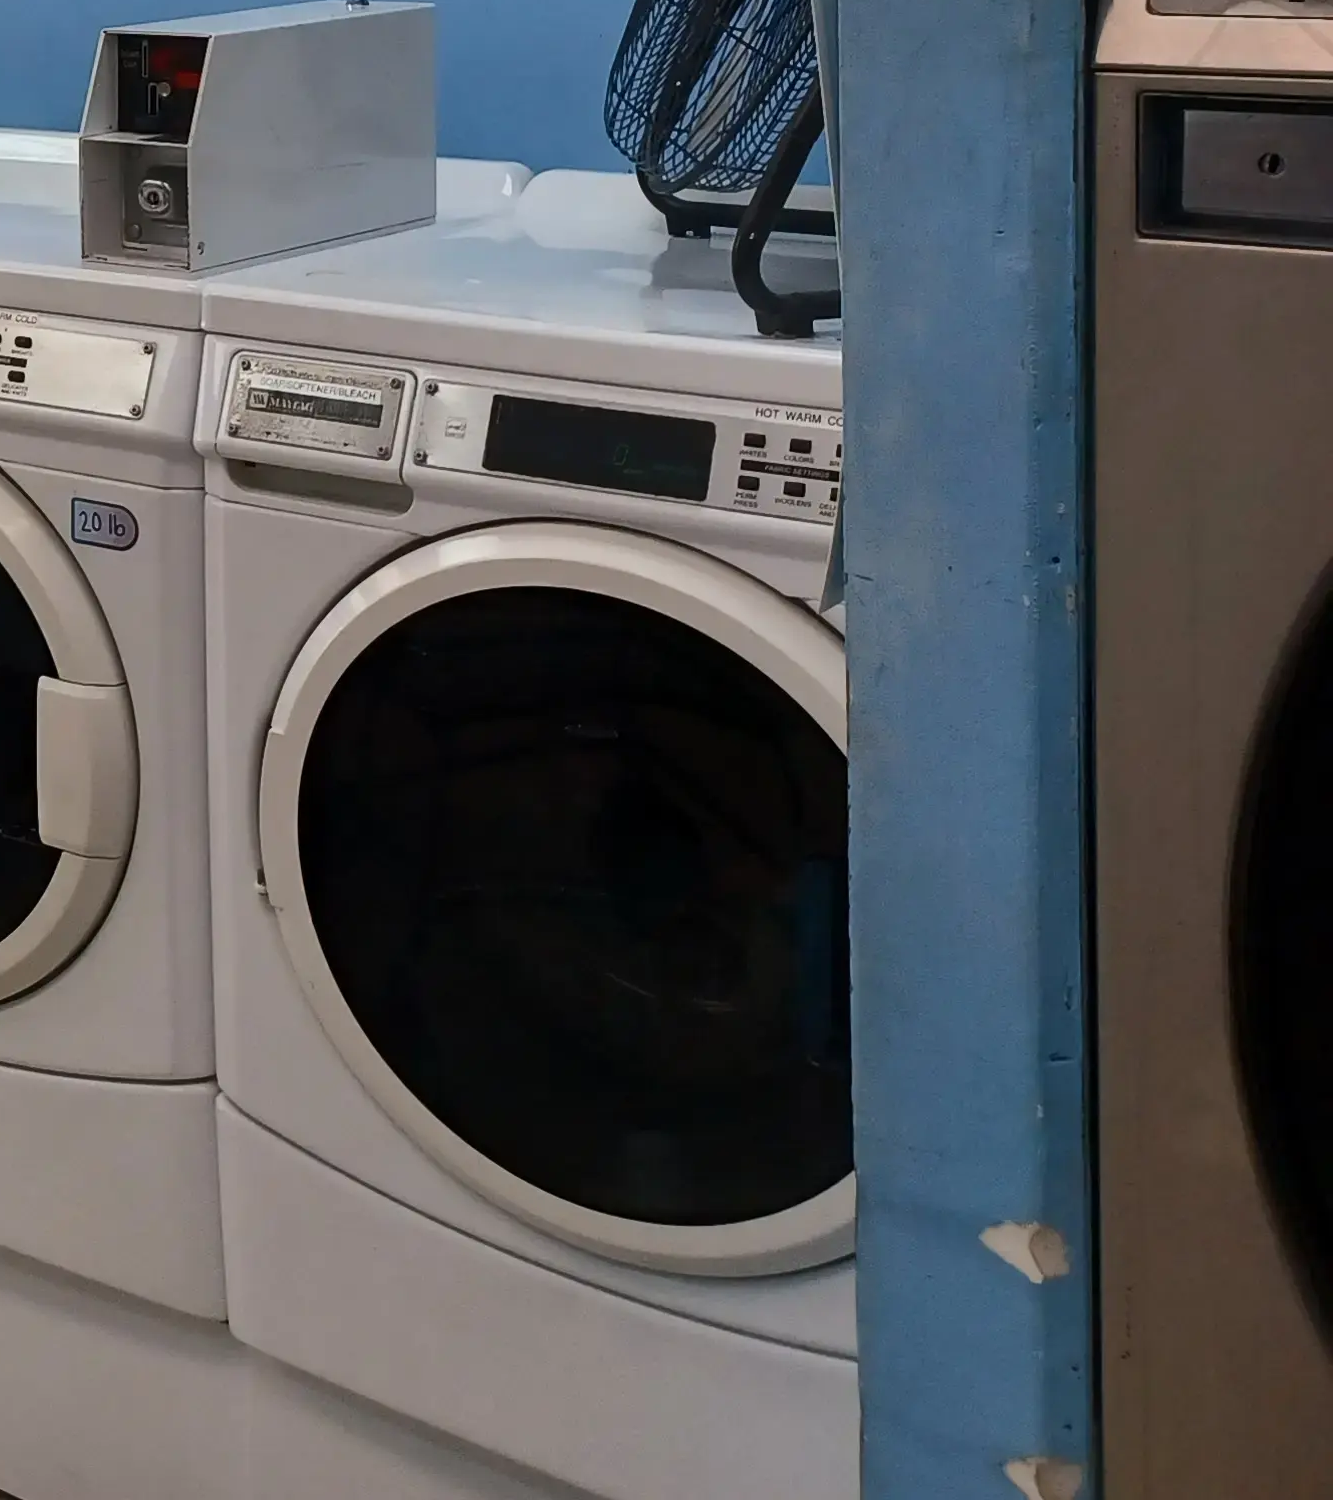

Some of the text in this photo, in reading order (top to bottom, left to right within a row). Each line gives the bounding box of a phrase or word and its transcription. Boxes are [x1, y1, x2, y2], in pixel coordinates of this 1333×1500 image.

[15, 314, 38, 325] COLD
[268, 396, 314, 413] MAYTAG
[754, 407, 843, 428] HOT WARM CO
[78, 510, 126, 537] 20 lb
